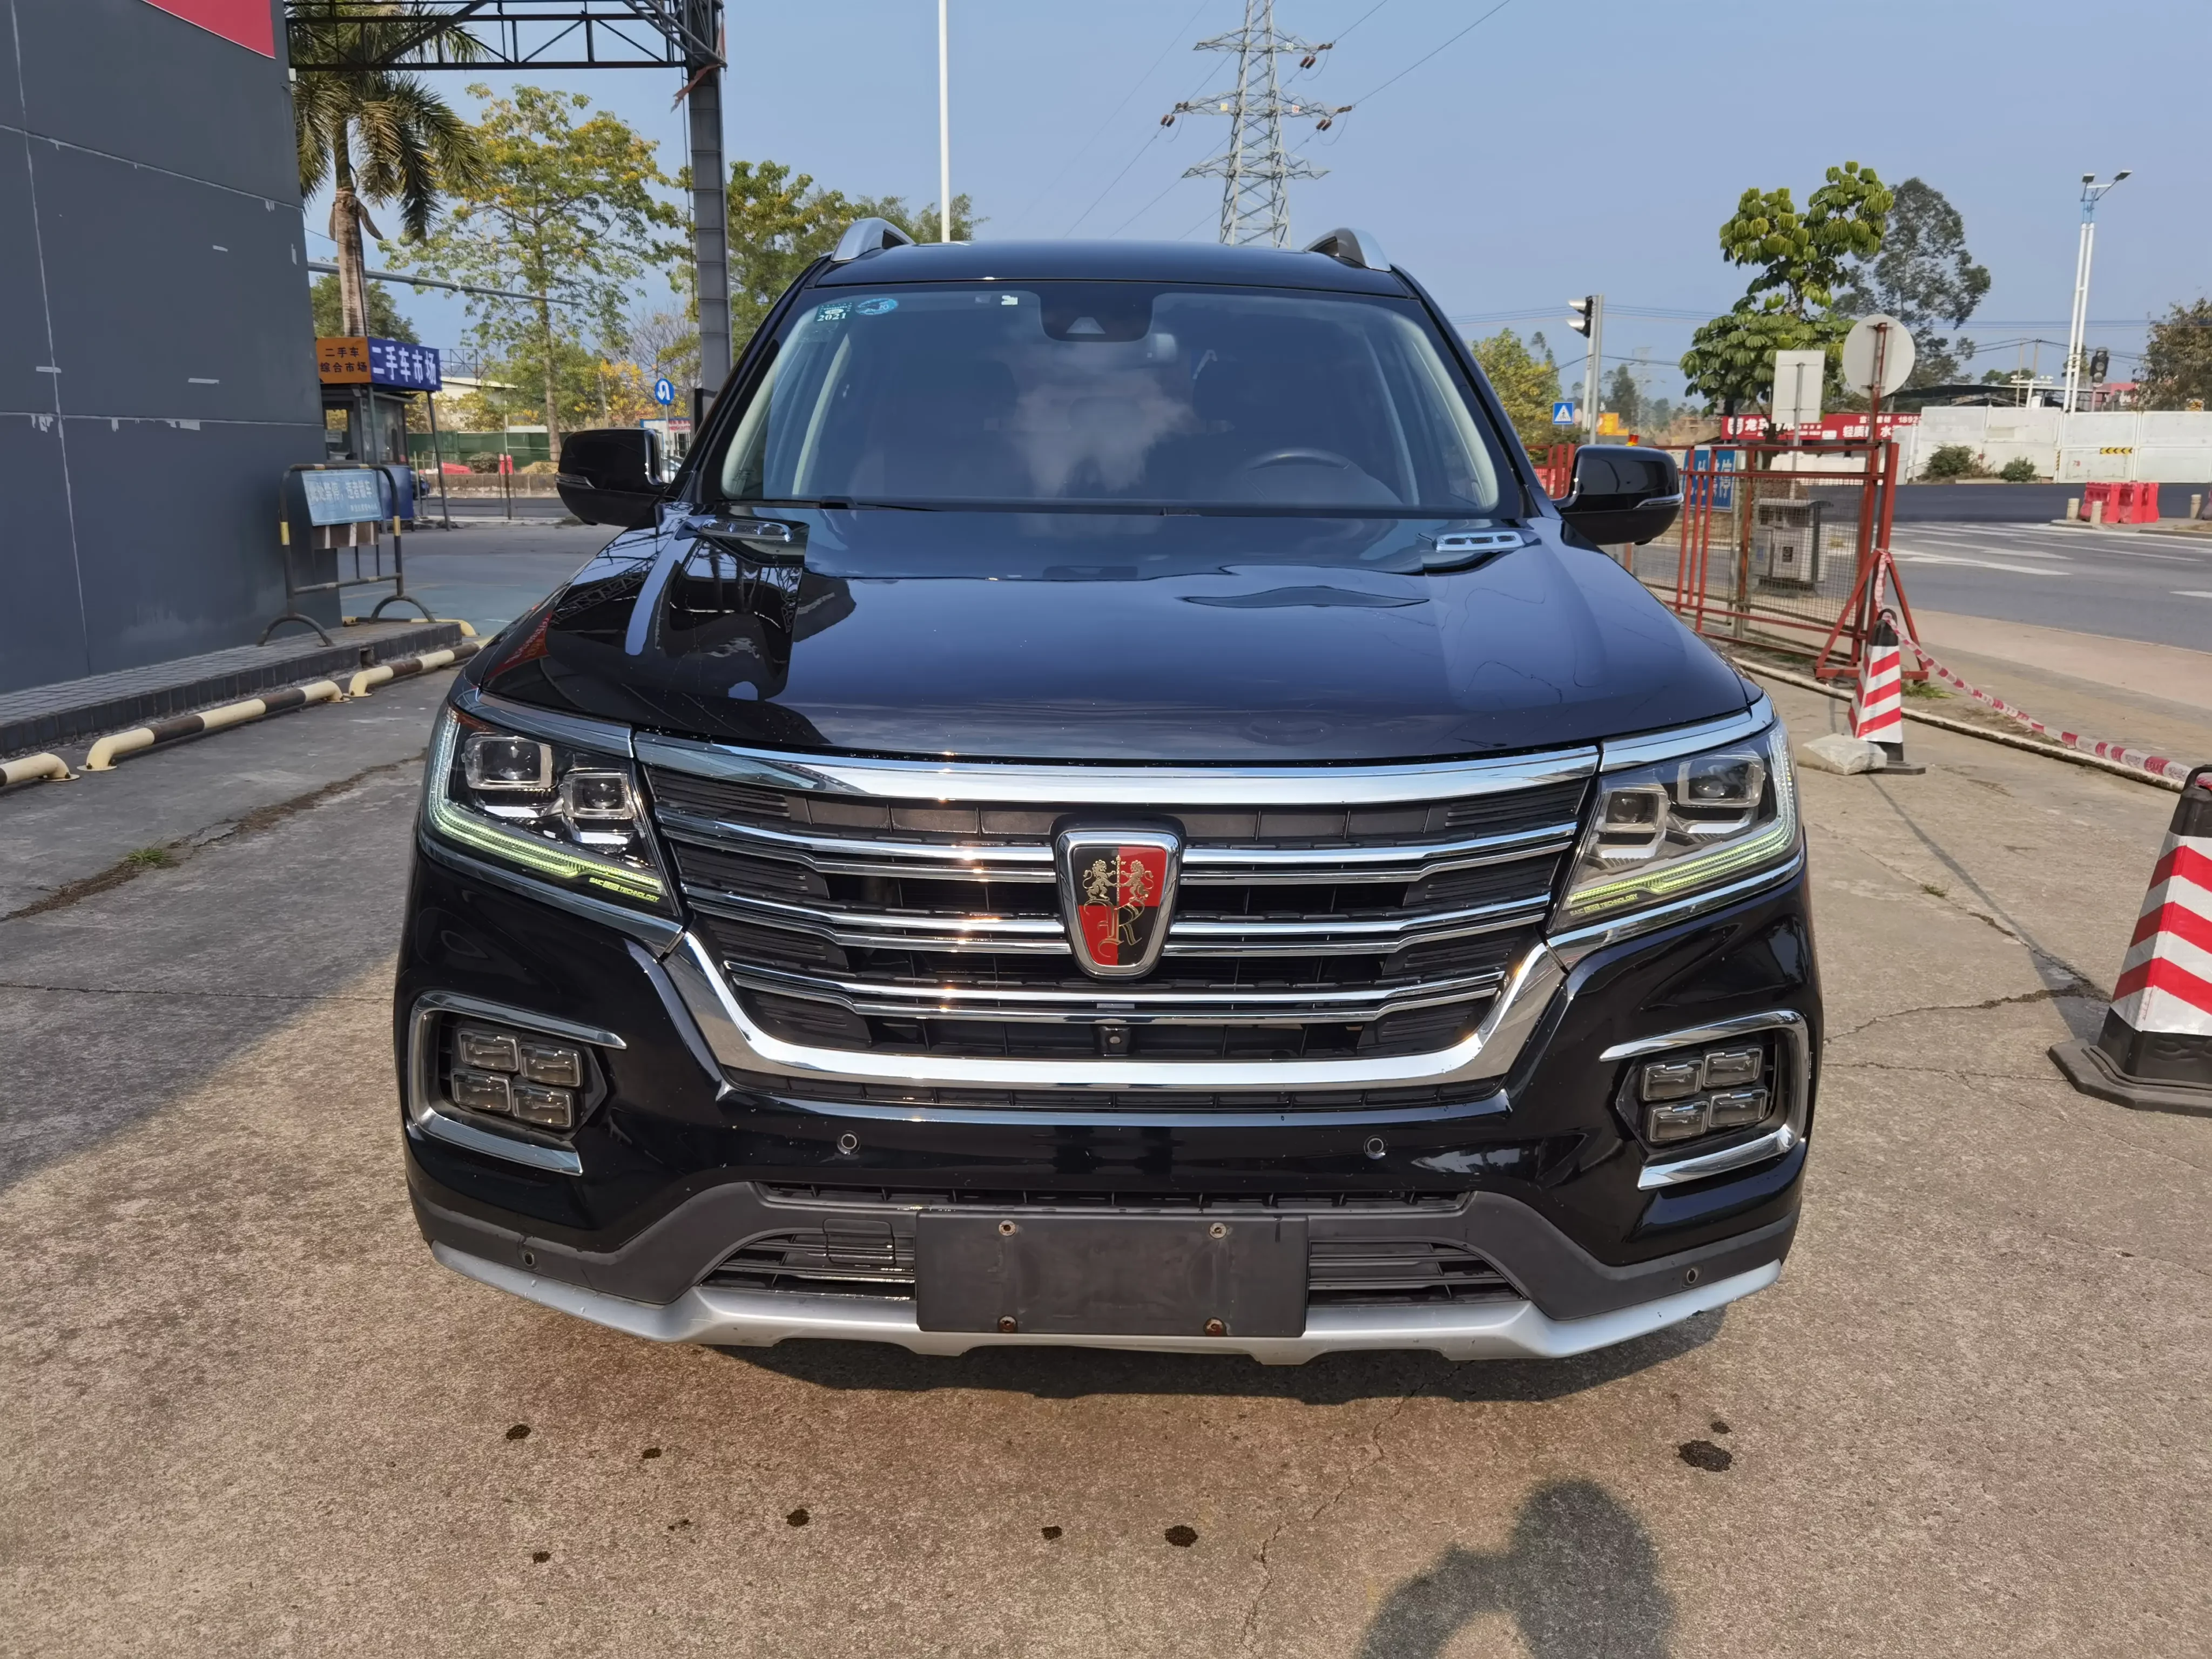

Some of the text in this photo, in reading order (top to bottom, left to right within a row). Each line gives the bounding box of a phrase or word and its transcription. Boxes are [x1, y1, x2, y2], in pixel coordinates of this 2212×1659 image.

[817, 312, 847, 322] 2021
[326, 347, 360, 358] 二手车
[320, 361, 368, 373] 综合市场
[371, 346, 437, 385] 二手车市场
[619, 886, 659, 902] TECHNOLOGY
[1569, 908, 1584, 916] SAIC
[1600, 893, 1638, 908] TECHNOLOGY
